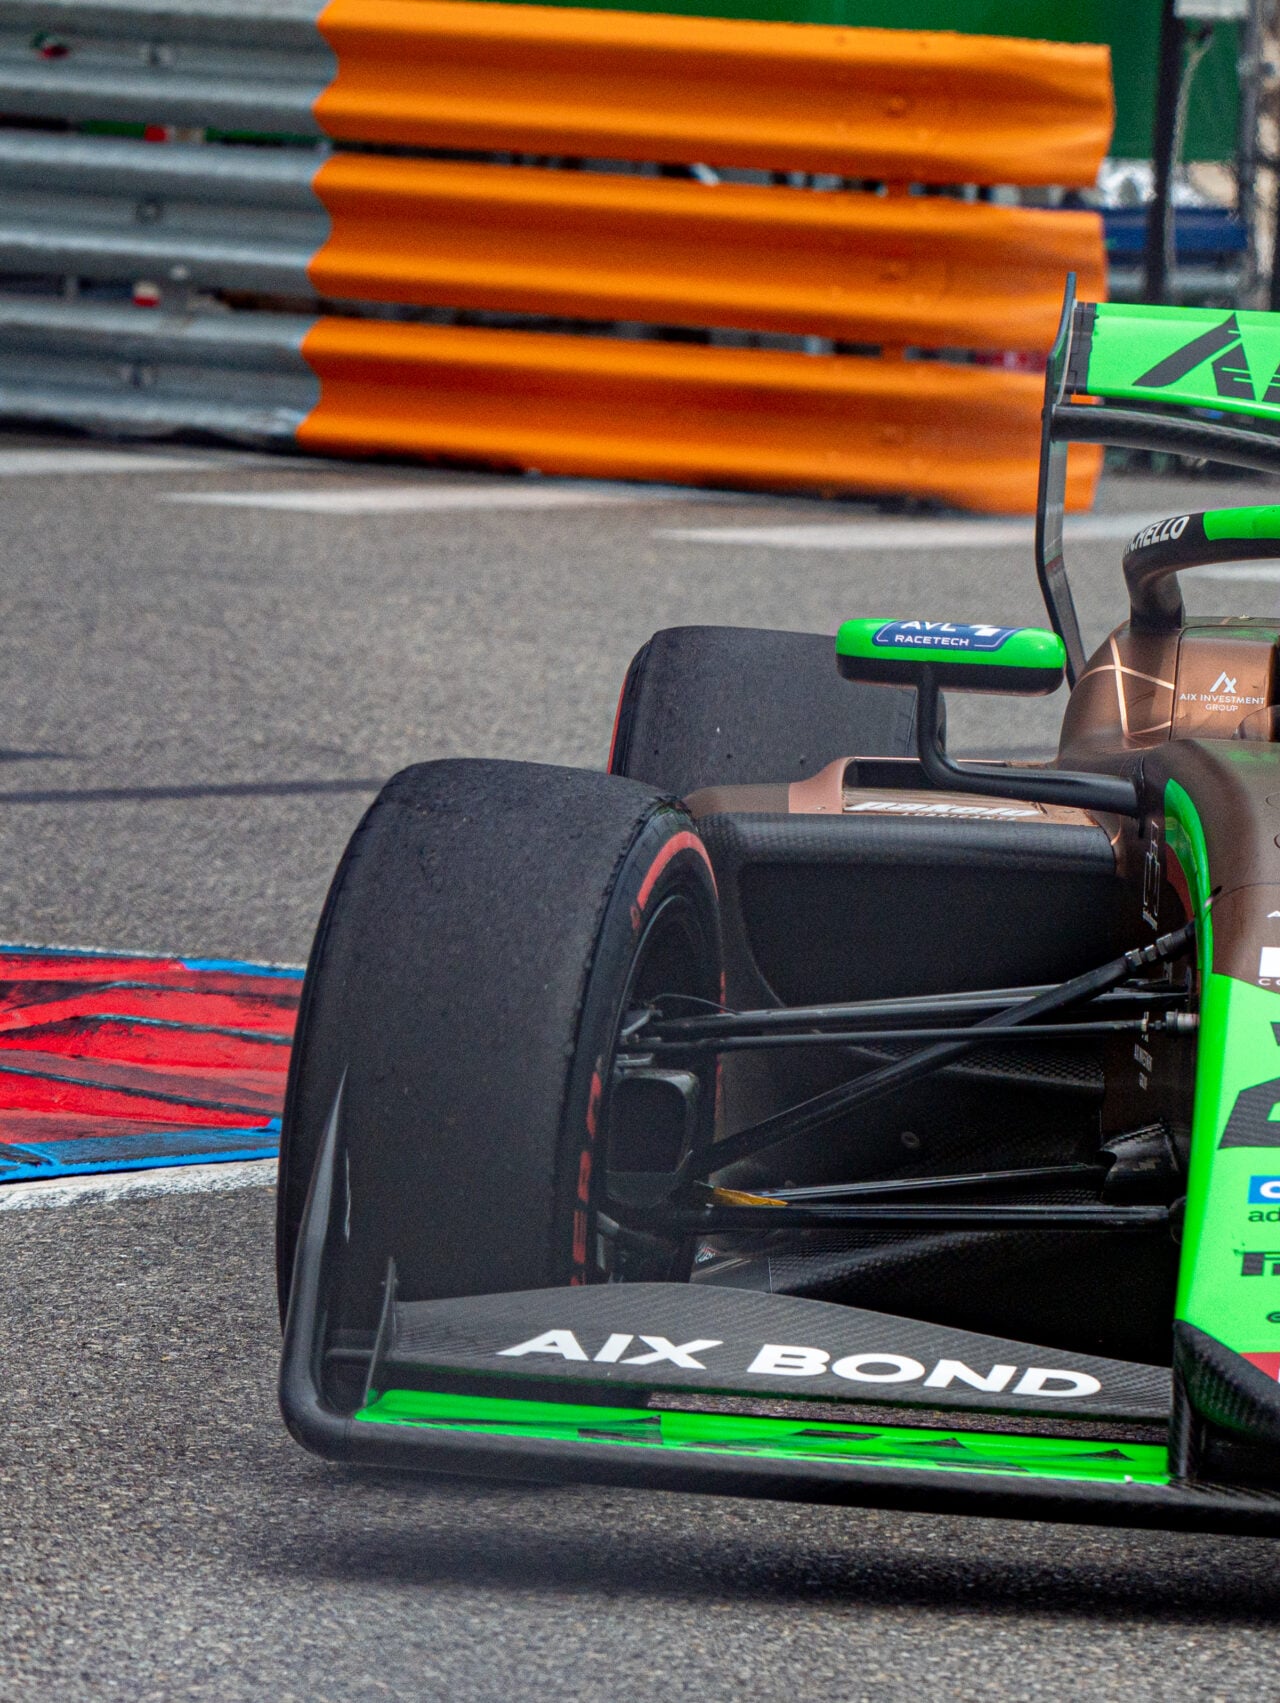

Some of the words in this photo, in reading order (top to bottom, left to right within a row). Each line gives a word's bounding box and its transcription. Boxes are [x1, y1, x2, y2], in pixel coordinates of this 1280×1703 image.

[895, 635, 970, 646] RACETECH
[1180, 693, 1197, 701] AIX
[1200, 694, 1265, 705] INVESTMENT
[1205, 703, 1239, 712] GROUP
[496, 1329, 723, 1370] AIX
[746, 1344, 1101, 1398] BOND
